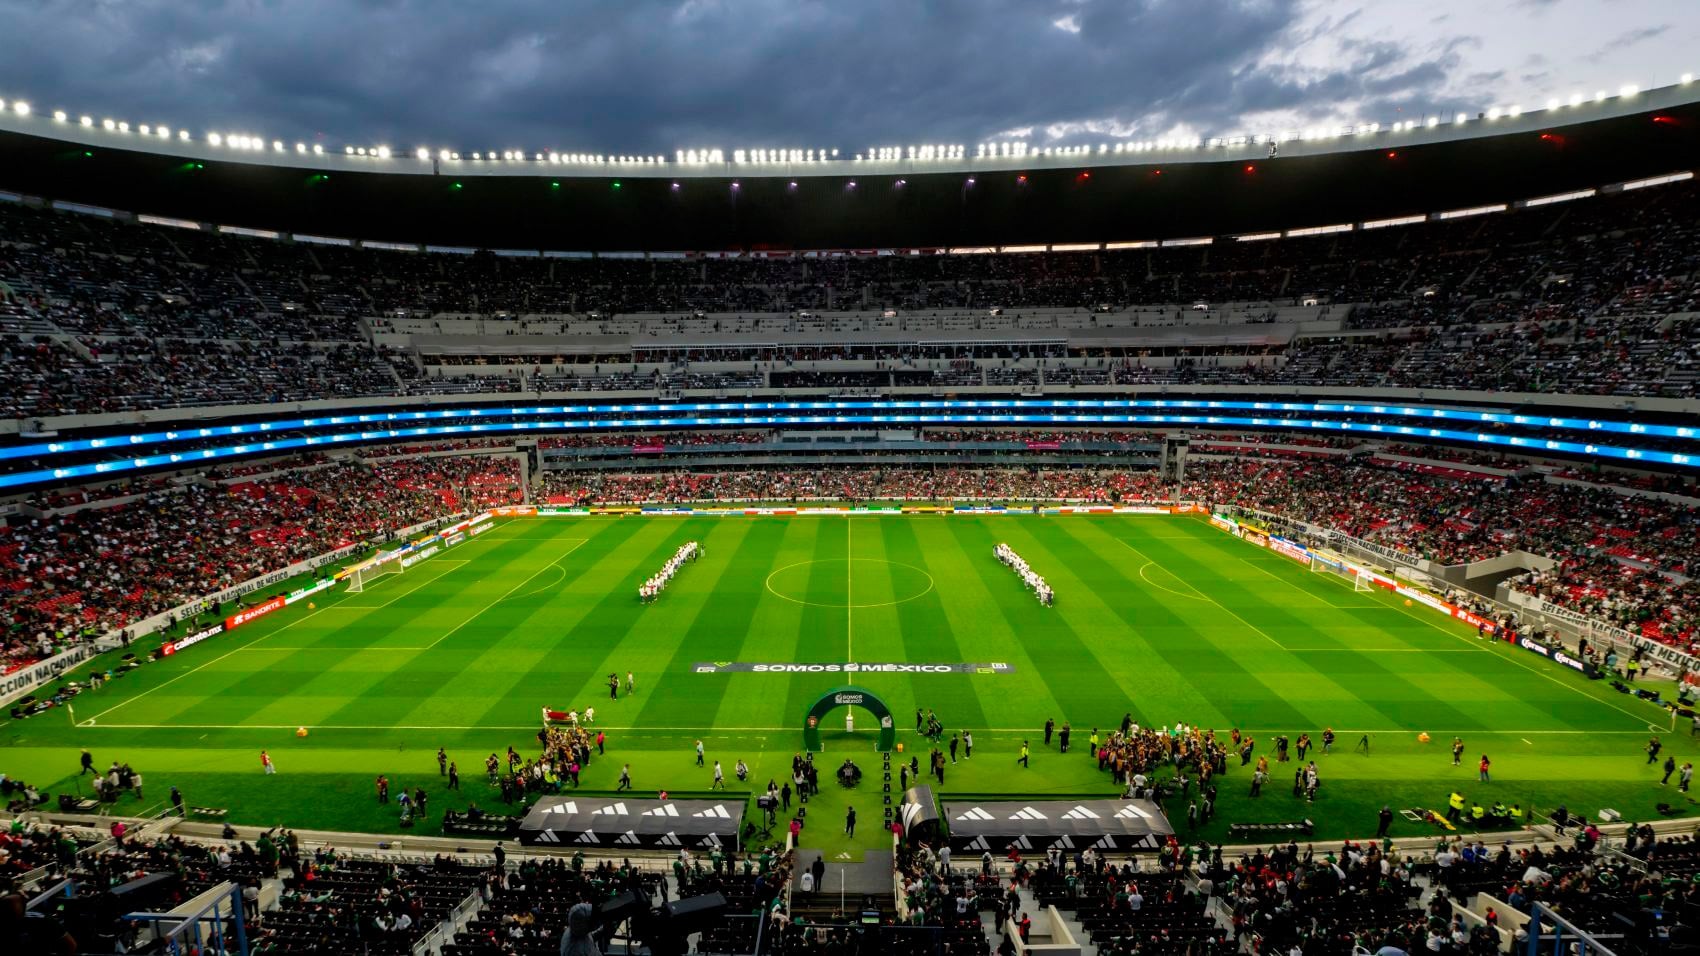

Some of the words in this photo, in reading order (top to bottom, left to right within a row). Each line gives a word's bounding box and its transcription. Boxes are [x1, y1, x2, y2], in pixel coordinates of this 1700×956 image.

[1387, 549, 1395, 559] DE
[181, 596, 220, 618] SELECN
[256, 579, 265, 589] DE
[244, 600, 281, 620] BANORTE
[174, 625, 222, 651] caliente.mx
[1643, 640, 1657, 655] DE
[35, 650, 85, 681] NACONAL
[752, 664, 841, 672] SOMOS
[861, 663, 952, 672] MÉXICO
